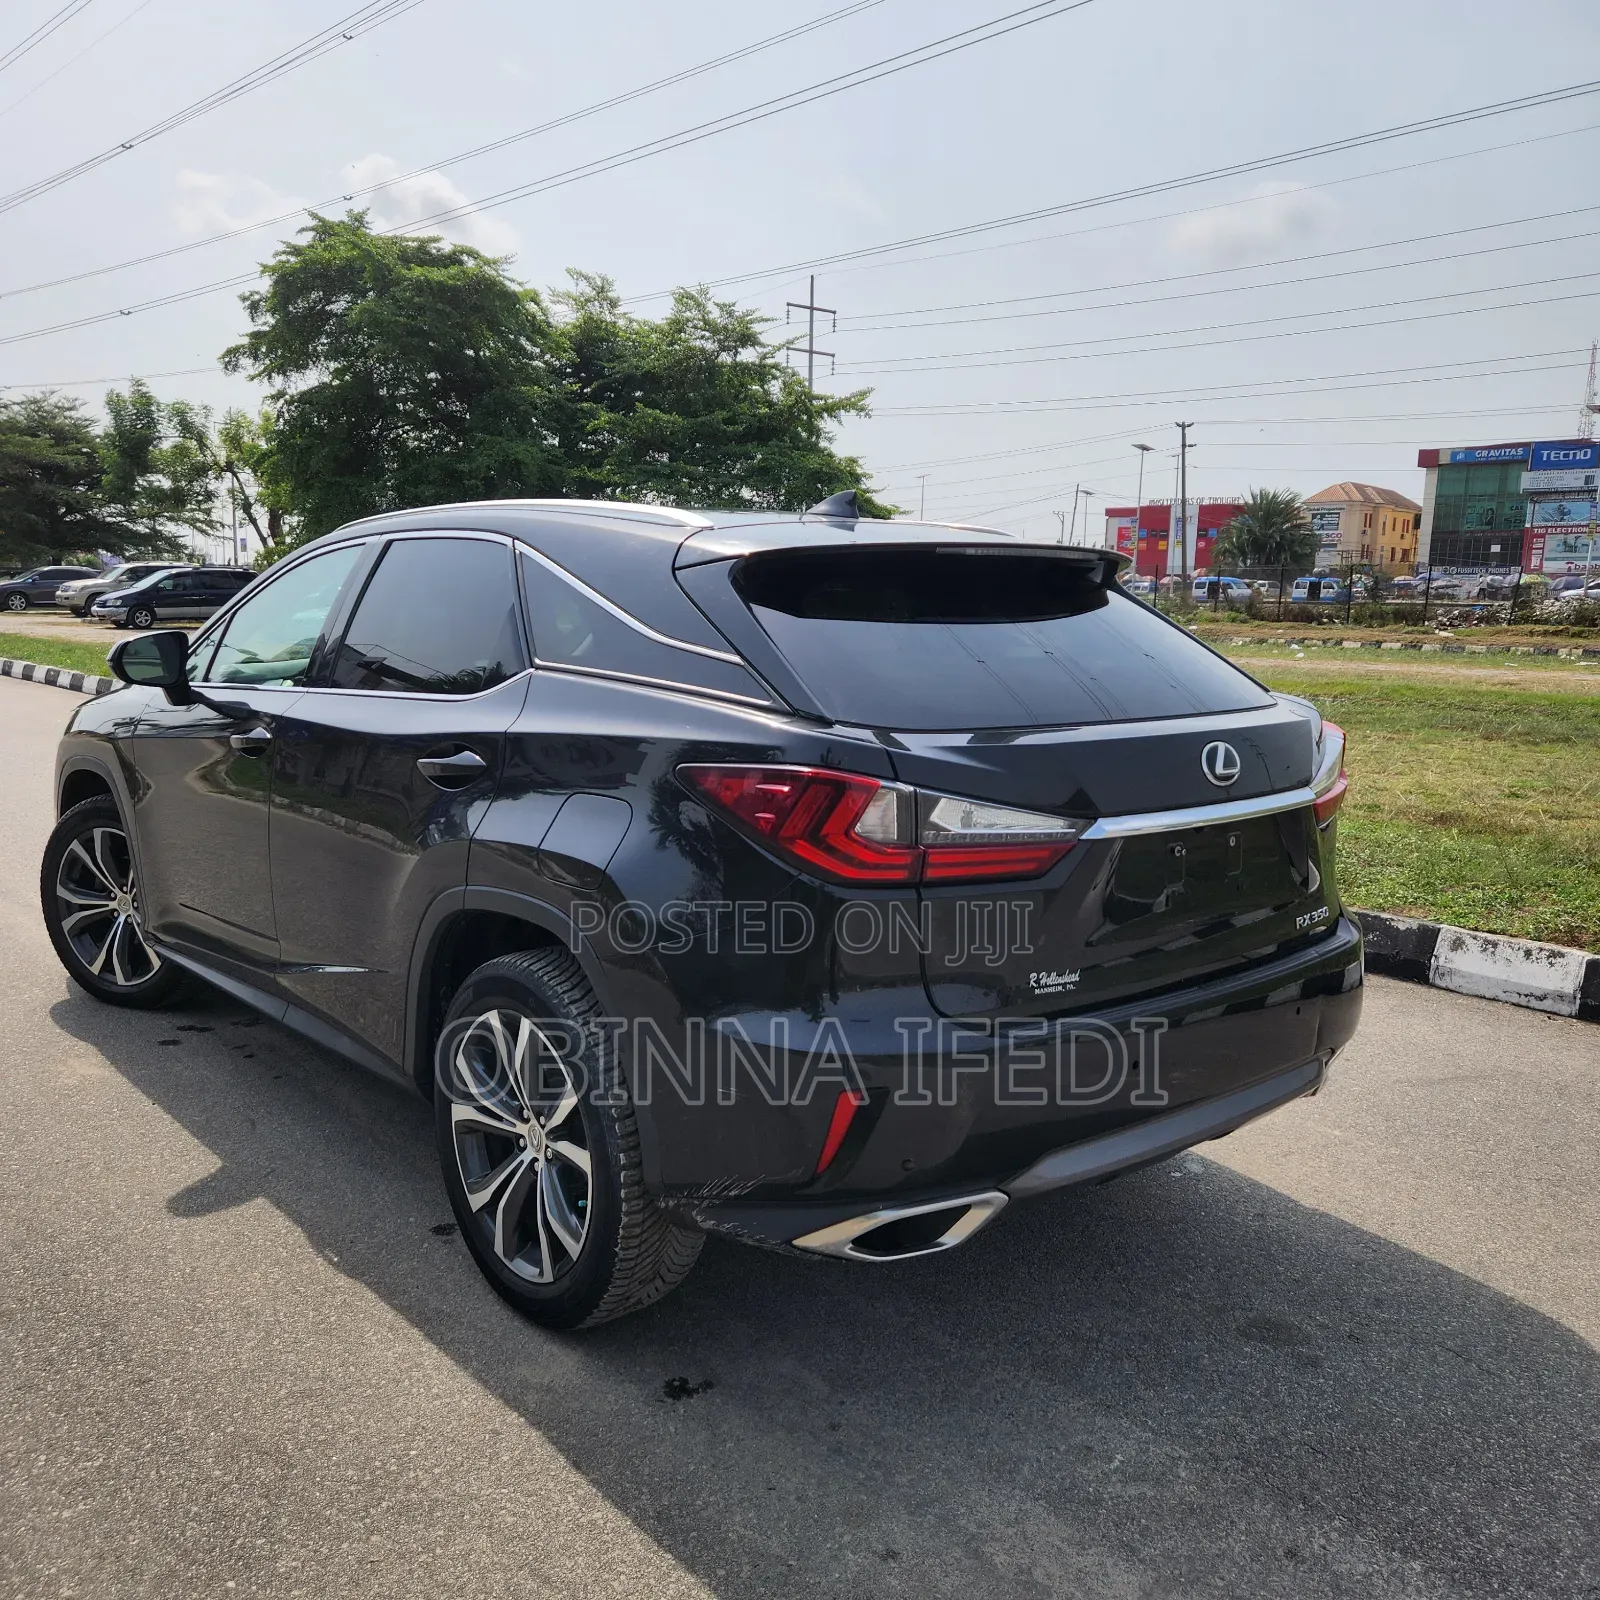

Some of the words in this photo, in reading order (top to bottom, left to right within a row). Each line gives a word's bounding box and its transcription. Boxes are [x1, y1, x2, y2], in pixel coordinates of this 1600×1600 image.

[1475, 448, 1524, 458] GRAVITAS
[1541, 449, 1591, 461] TECNO
[1208, 496, 1241, 505] THOUGHT
[1547, 526, 1600, 534] ELECTRONS
[1487, 566, 1510, 574] PHONES
